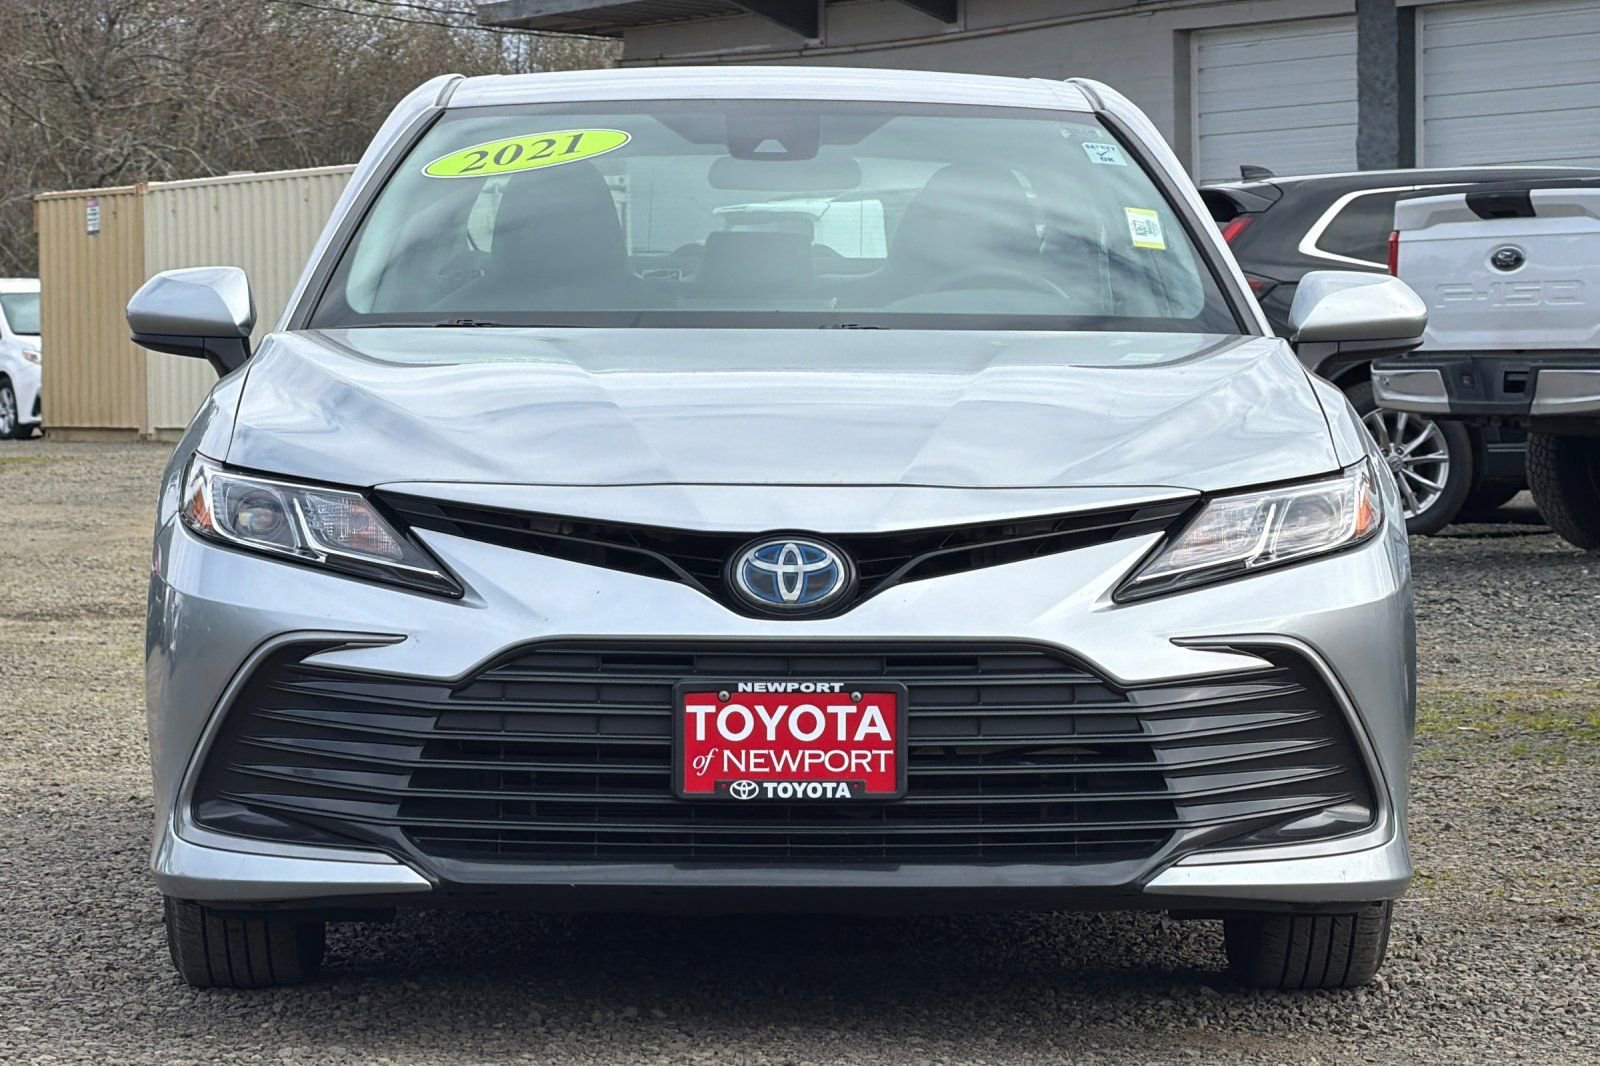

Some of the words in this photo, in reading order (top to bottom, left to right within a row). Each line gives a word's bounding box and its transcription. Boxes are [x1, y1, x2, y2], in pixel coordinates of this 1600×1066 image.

[458, 132, 585, 174] 2021
[1435, 279, 1586, 309] F-150
[737, 682, 845, 693] NEWPORT
[685, 703, 892, 742] TOYOTA
[692, 747, 719, 777] of
[722, 749, 894, 773] NEWPORT
[763, 782, 852, 799] TOYOTA
